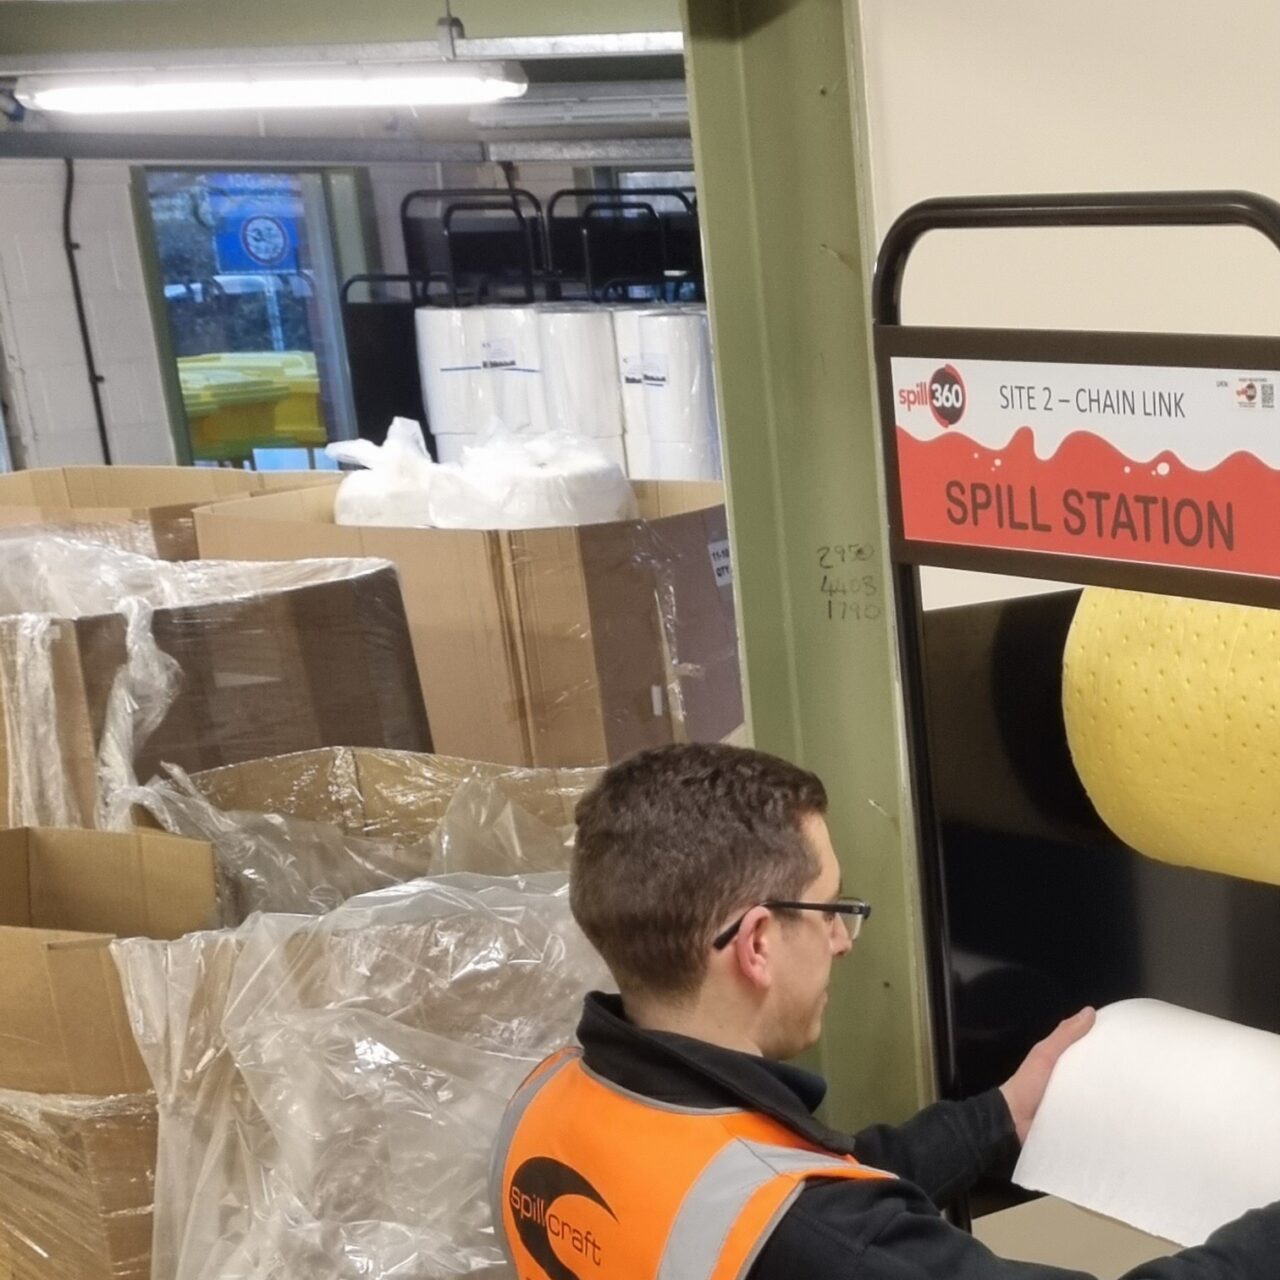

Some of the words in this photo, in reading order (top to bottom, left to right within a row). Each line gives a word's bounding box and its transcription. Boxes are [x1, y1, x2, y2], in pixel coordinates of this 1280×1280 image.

[898, 382, 963, 412] spill360
[999, 384, 1037, 411] SITE
[1042, 386, 1054, 411] 2
[1075, 387, 1137, 416] CHAIN
[1142, 390, 1187, 418] LINK
[945, 479, 1052, 533] SPILL
[1063, 488, 1236, 552] STATION
